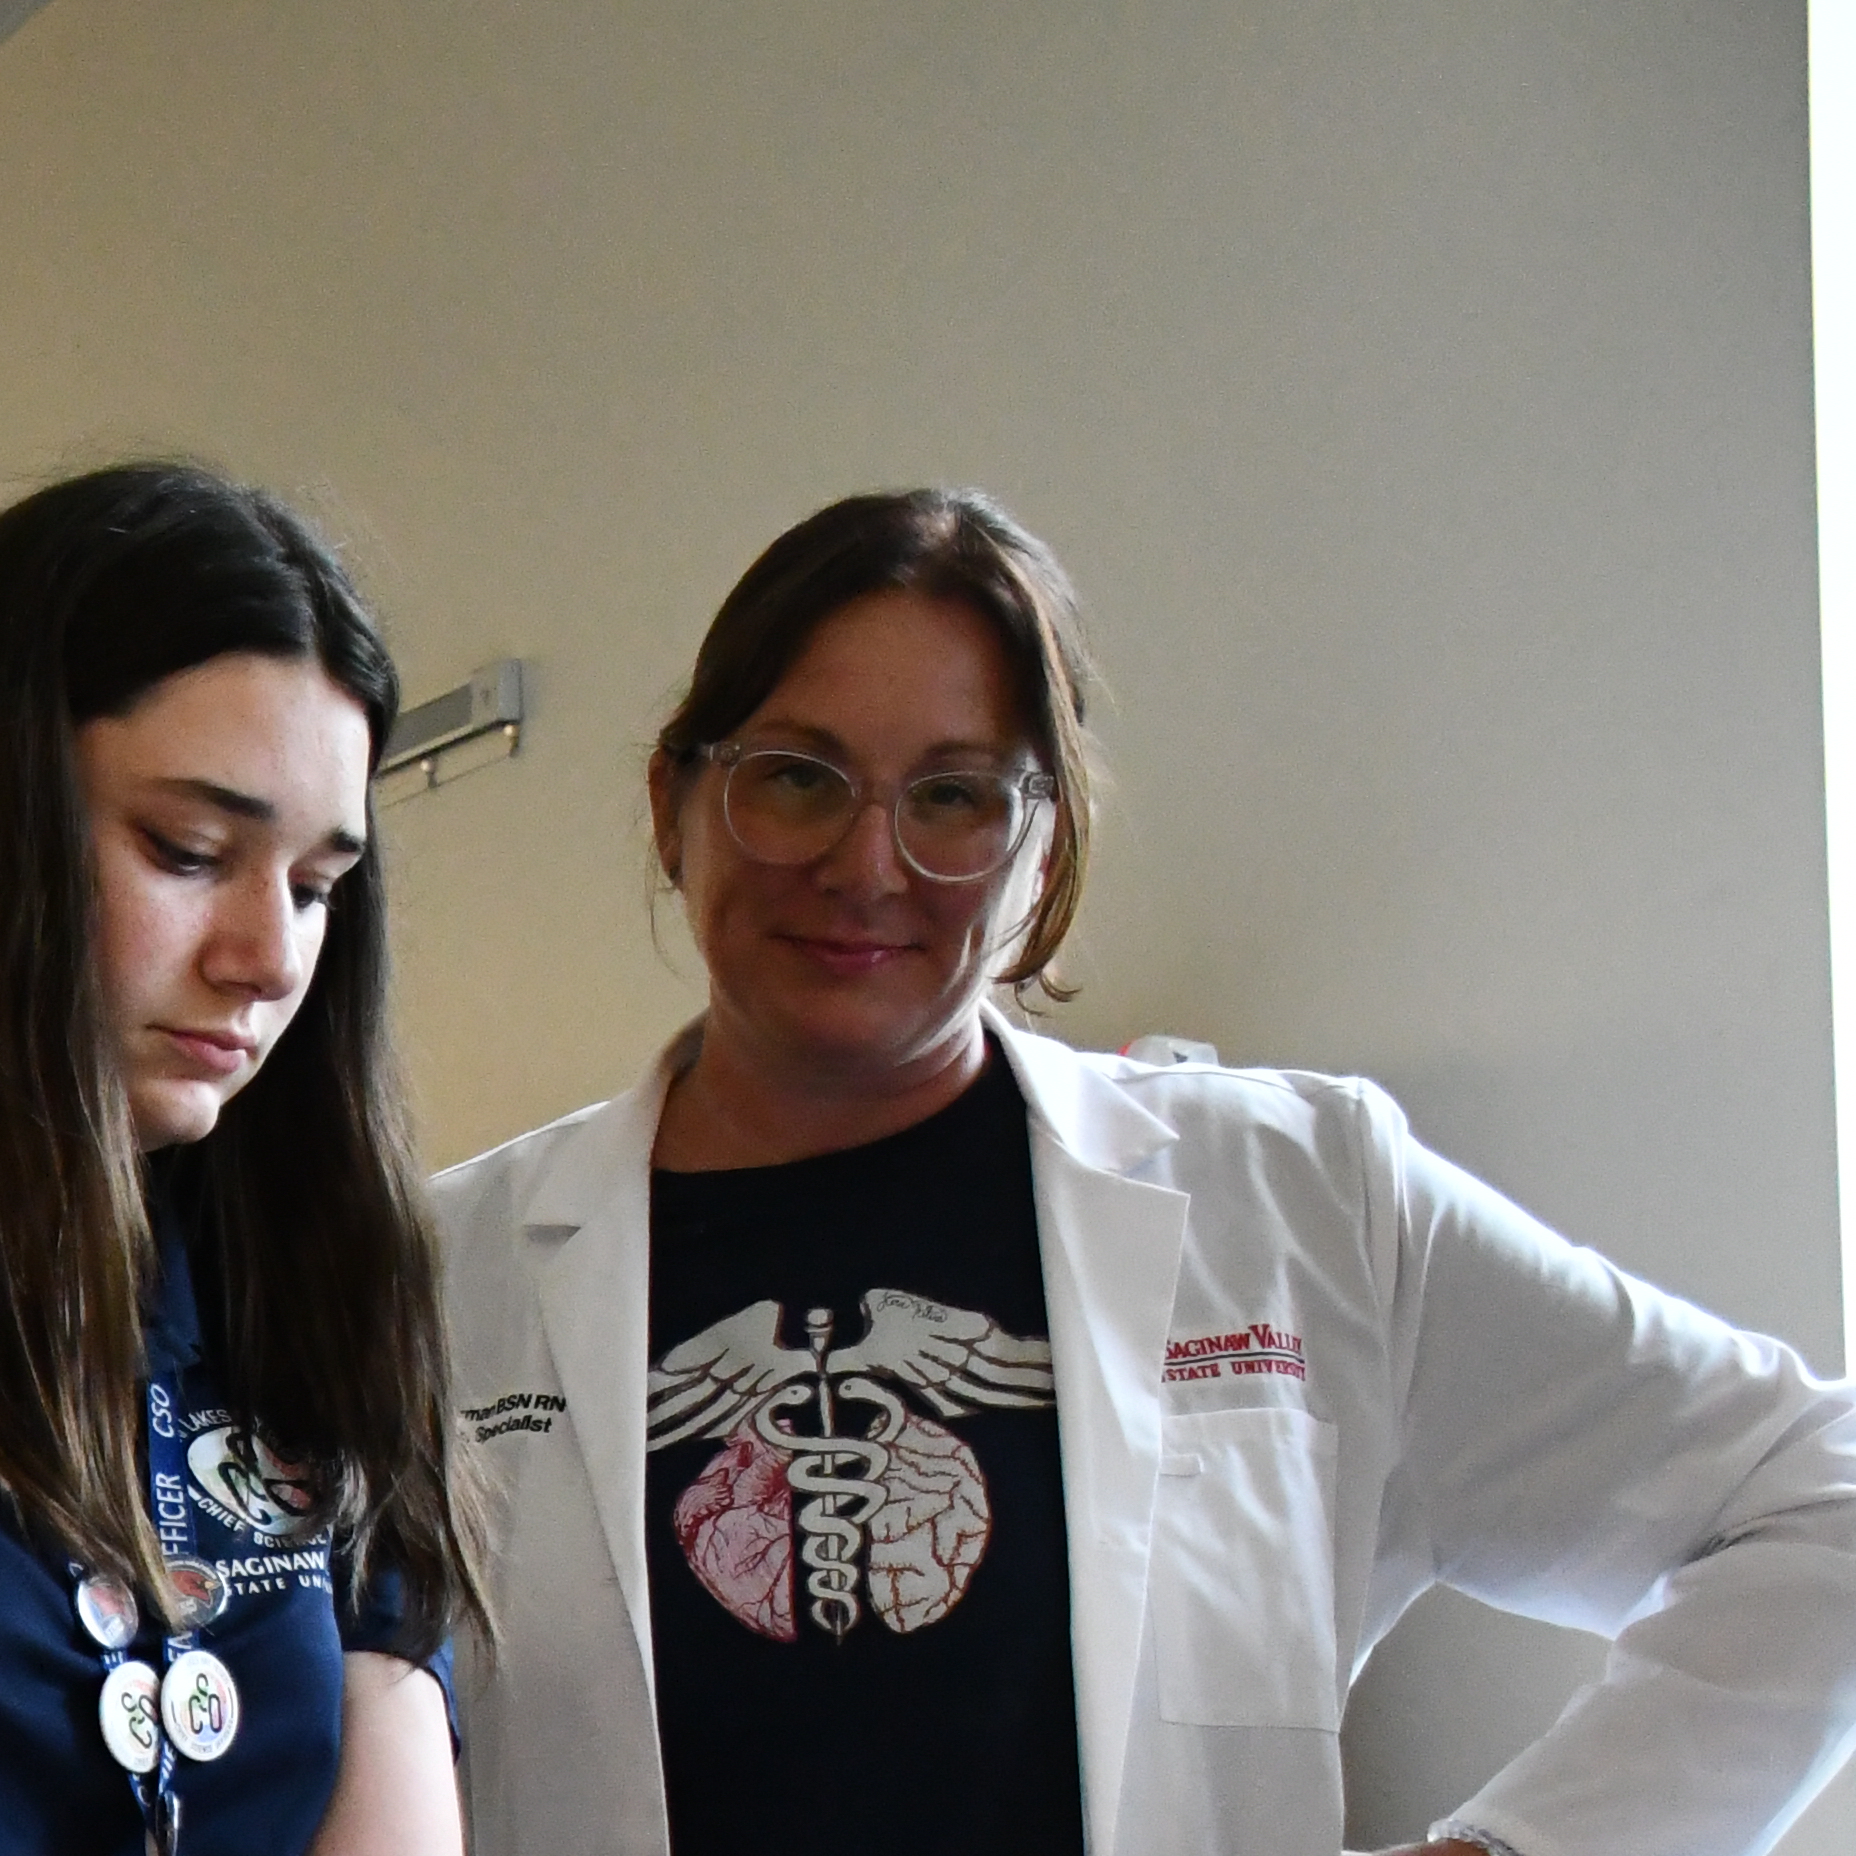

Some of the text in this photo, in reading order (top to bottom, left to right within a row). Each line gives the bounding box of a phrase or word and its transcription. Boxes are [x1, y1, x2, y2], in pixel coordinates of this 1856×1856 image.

[1164, 1363, 1221, 1382] STATE
[151, 1383, 175, 1438] CSO
[496, 1393, 533, 1415] BSN
[533, 1394, 567, 1413] RN
[178, 1408, 232, 1432] LAKES
[155, 1472, 189, 1556] FFICER
[197, 1497, 328, 1549] CHIEF SCIE
[215, 1551, 325, 1579] SAGINAW
